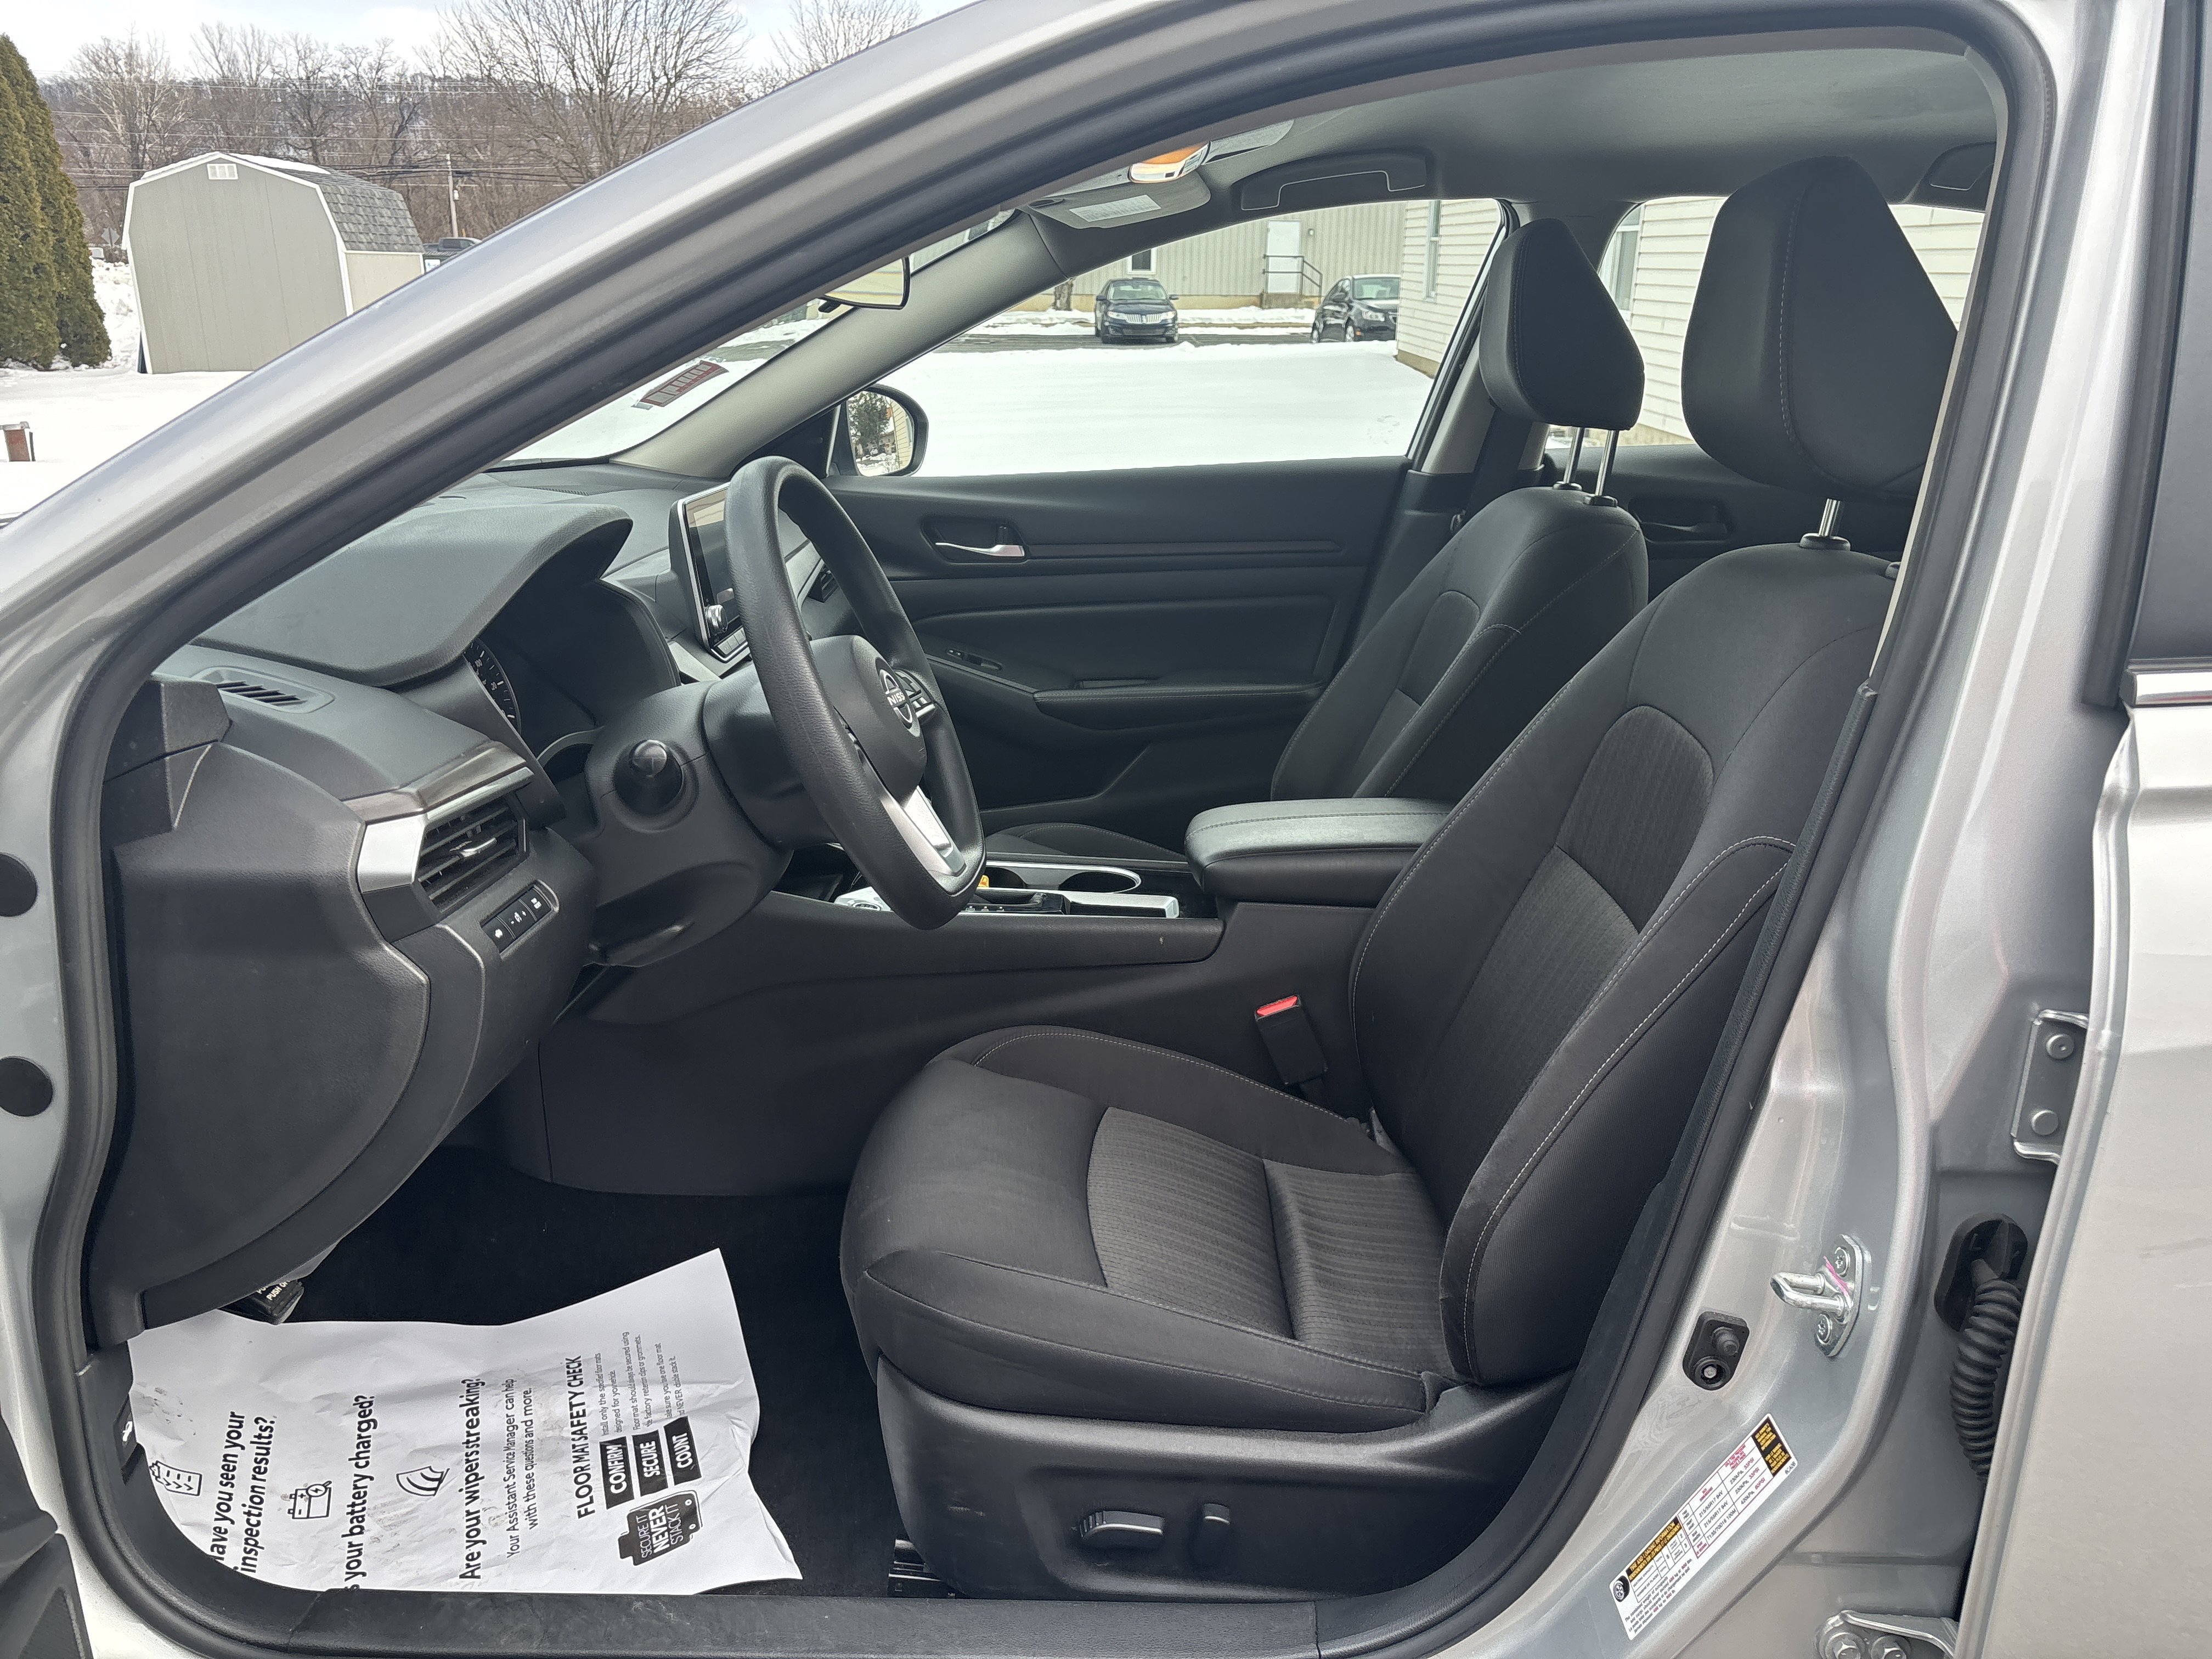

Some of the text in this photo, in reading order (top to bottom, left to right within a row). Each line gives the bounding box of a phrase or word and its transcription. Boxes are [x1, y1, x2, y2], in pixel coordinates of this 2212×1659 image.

[267, 1286, 283, 1301] PUSH
[622, 1347, 631, 1365] secured
[628, 1384, 637, 1403] should
[663, 1383, 671, 1395] you
[675, 1389, 684, 1409] NEVER
[224, 1412, 245, 1450] your
[348, 1396, 377, 1469] charged?
[600, 1407, 608, 1420] only
[566, 1356, 595, 1519] FLOOR MAT SAFETY CHECK
[672, 1433, 692, 1468] COUNT
[219, 1454, 238, 1488] seen
[458, 1379, 487, 1579] Are your wipers streaking?
[501, 1379, 520, 1558] Your Assistant Service Manager can help
[521, 1388, 538, 1530] with these questions and more.
[606, 1444, 627, 1493] CONFIRM
[640, 1441, 660, 1477] SECURE
[214, 1491, 235, 1525] you
[233, 1417, 275, 1573] inspection results?
[341, 1474, 374, 1538] battery
[636, 1515, 652, 1558] SECURE IT
[649, 1505, 669, 1553] NEVER
[665, 1504, 683, 1544] STACK IT
[345, 1541, 366, 1582] your
